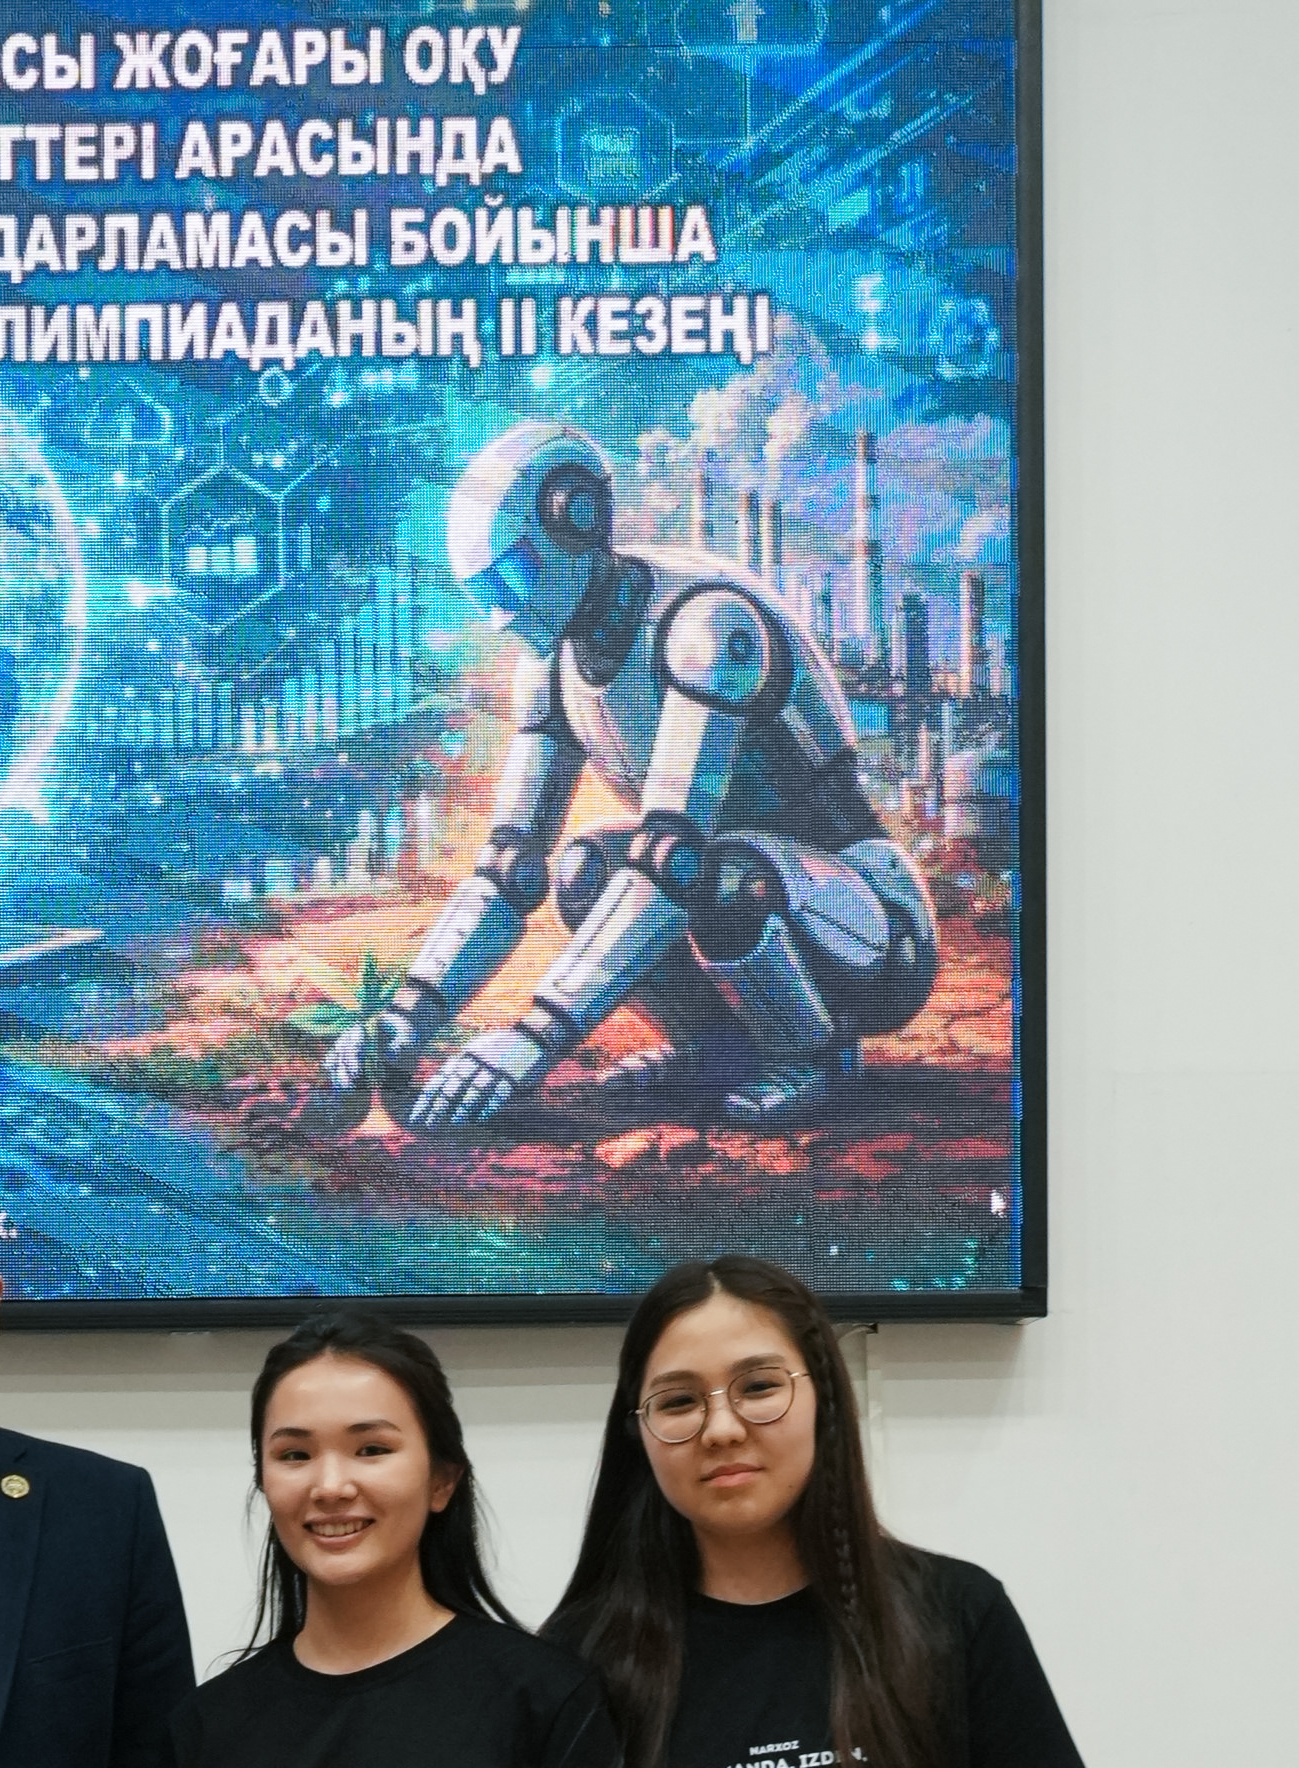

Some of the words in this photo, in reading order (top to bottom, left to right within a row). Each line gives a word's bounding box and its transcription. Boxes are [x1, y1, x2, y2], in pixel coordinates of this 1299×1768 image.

[112, 28, 382, 92] ЖОҒАРЫ
[404, 25, 524, 94] ОҚУ
[176, 117, 523, 188] АРАСЫНДА
[391, 191, 719, 269] БОЙЫНША
[556, 294, 773, 367] КЕЗЕҢІ
